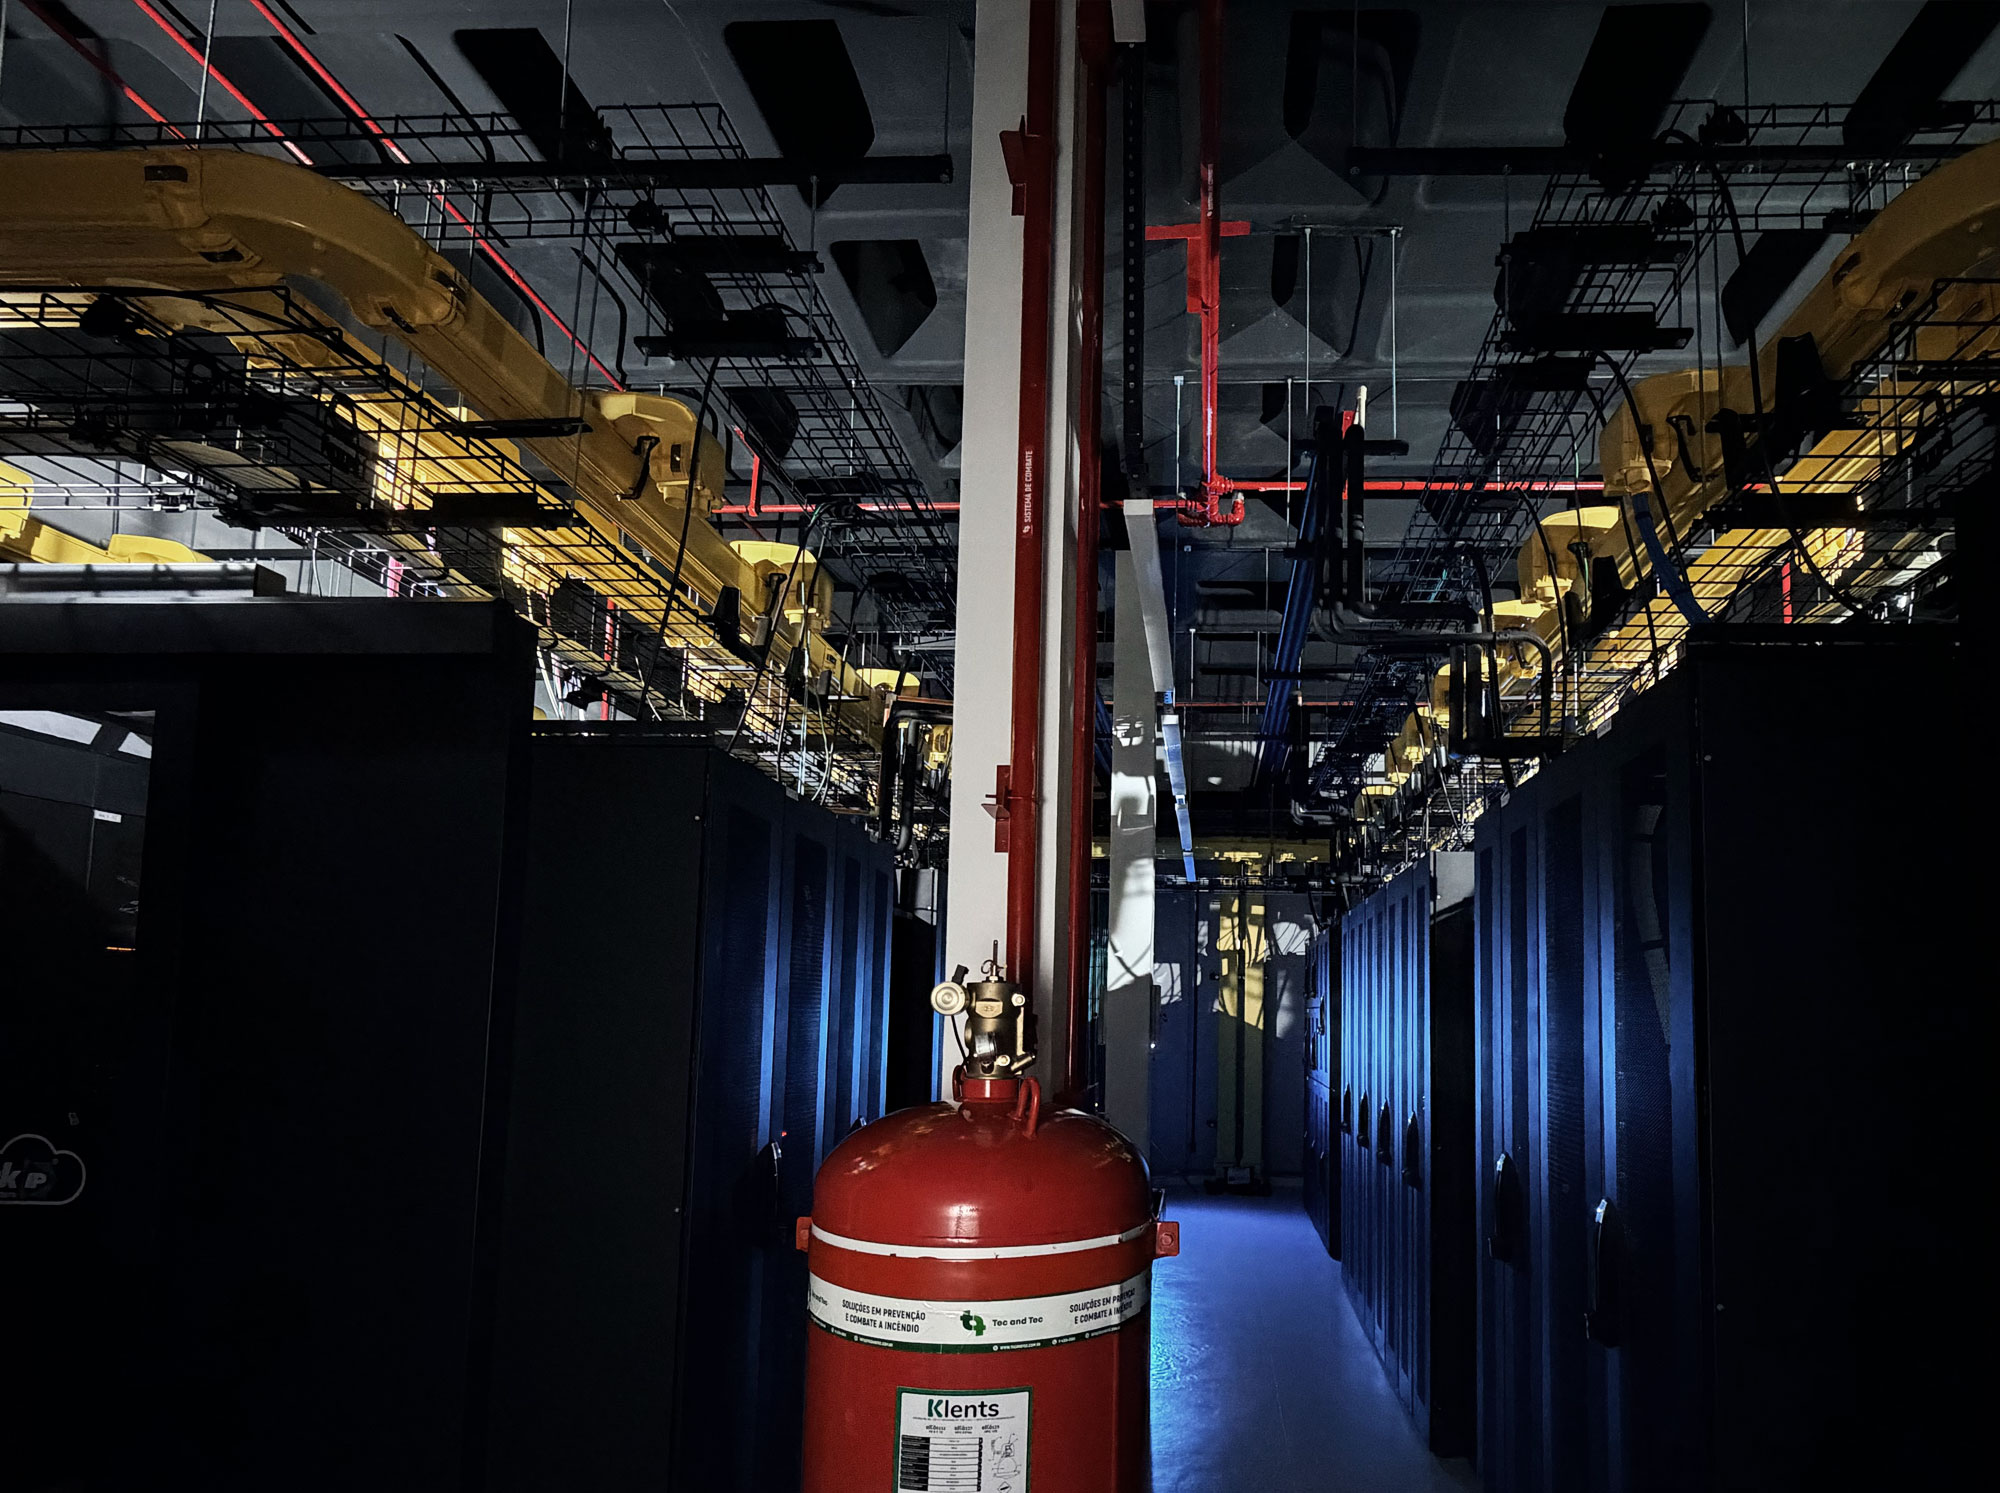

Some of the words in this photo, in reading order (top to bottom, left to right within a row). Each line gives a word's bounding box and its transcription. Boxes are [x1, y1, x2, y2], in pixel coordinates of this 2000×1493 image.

[1025, 450, 1033, 482] COMBATE
[1025, 483, 1032, 492] DE
[1024, 493, 1032, 523] SISTEMA
[842, 1299, 870, 1314] SOLUÇÕES
[871, 1306, 881, 1316] EM
[883, 1308, 926, 1322] PREVENÇÃO
[1069, 1298, 1101, 1313] SOLUÇÕES
[1102, 1296, 1111, 1306] EM
[845, 1313, 849, 1321] E
[849, 1314, 877, 1328] COMBATE
[878, 1320, 883, 1328] A
[884, 1320, 920, 1333] INCÊNDIO
[1010, 1317, 1027, 1326] and
[1028, 1316, 1043, 1324] Tec
[1074, 1316, 1078, 1325] E
[1079, 1309, 1107, 1323] COMBATE
[1108, 1308, 1113, 1316] A
[927, 1398, 999, 1418] Klents
